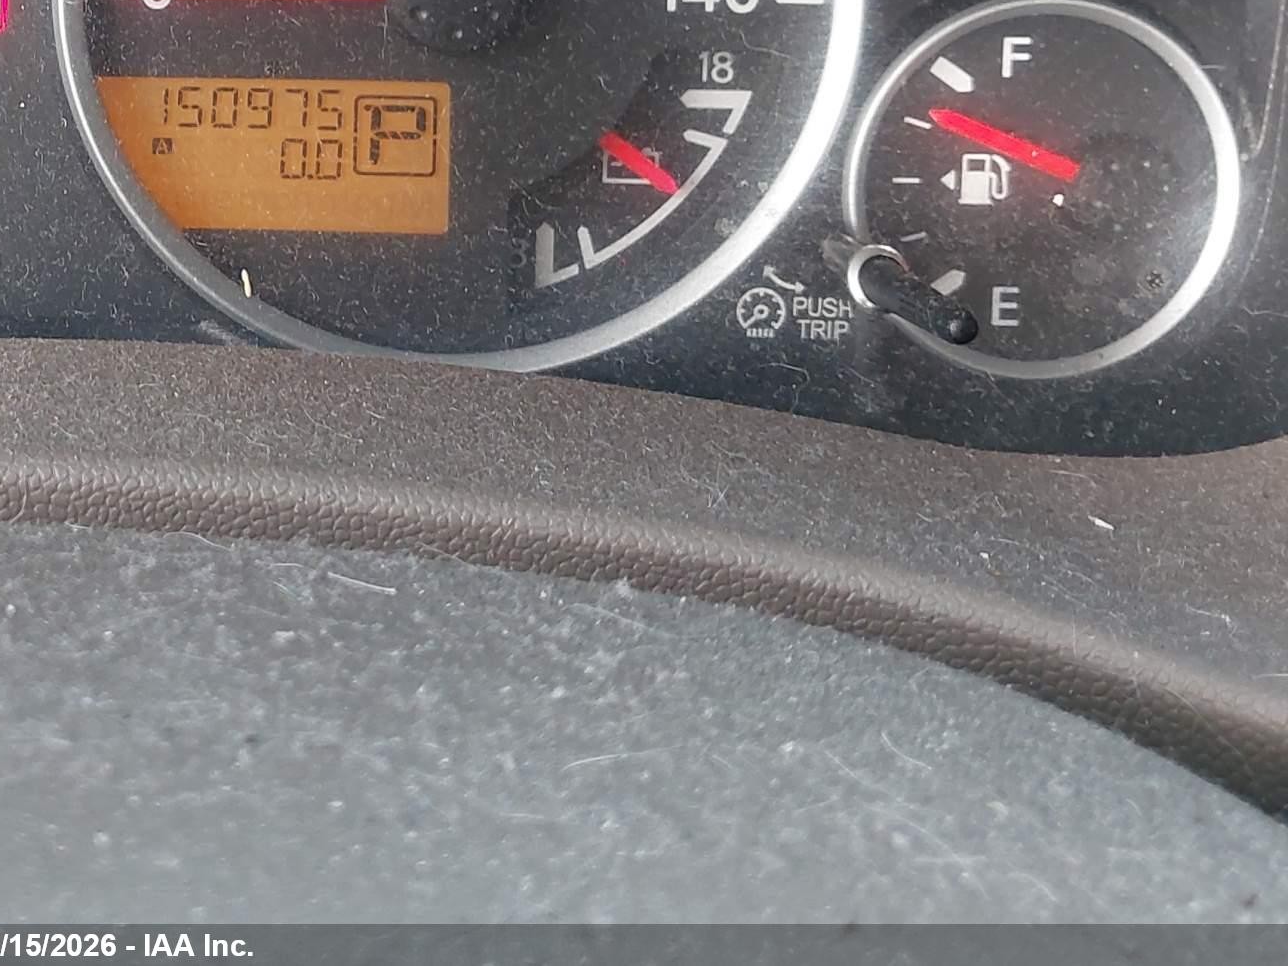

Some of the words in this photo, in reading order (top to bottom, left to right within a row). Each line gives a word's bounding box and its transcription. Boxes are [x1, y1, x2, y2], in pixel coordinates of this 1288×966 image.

[700, 52, 734, 83] 18
[1002, 37, 1032, 77] F
[162, 86, 344, 130] 150975
[365, 104, 427, 165] P
[280, 138, 343, 180] 0.0
[793, 297, 854, 318] PUSH
[991, 287, 1019, 326] E
[797, 320, 850, 341] TRIP
